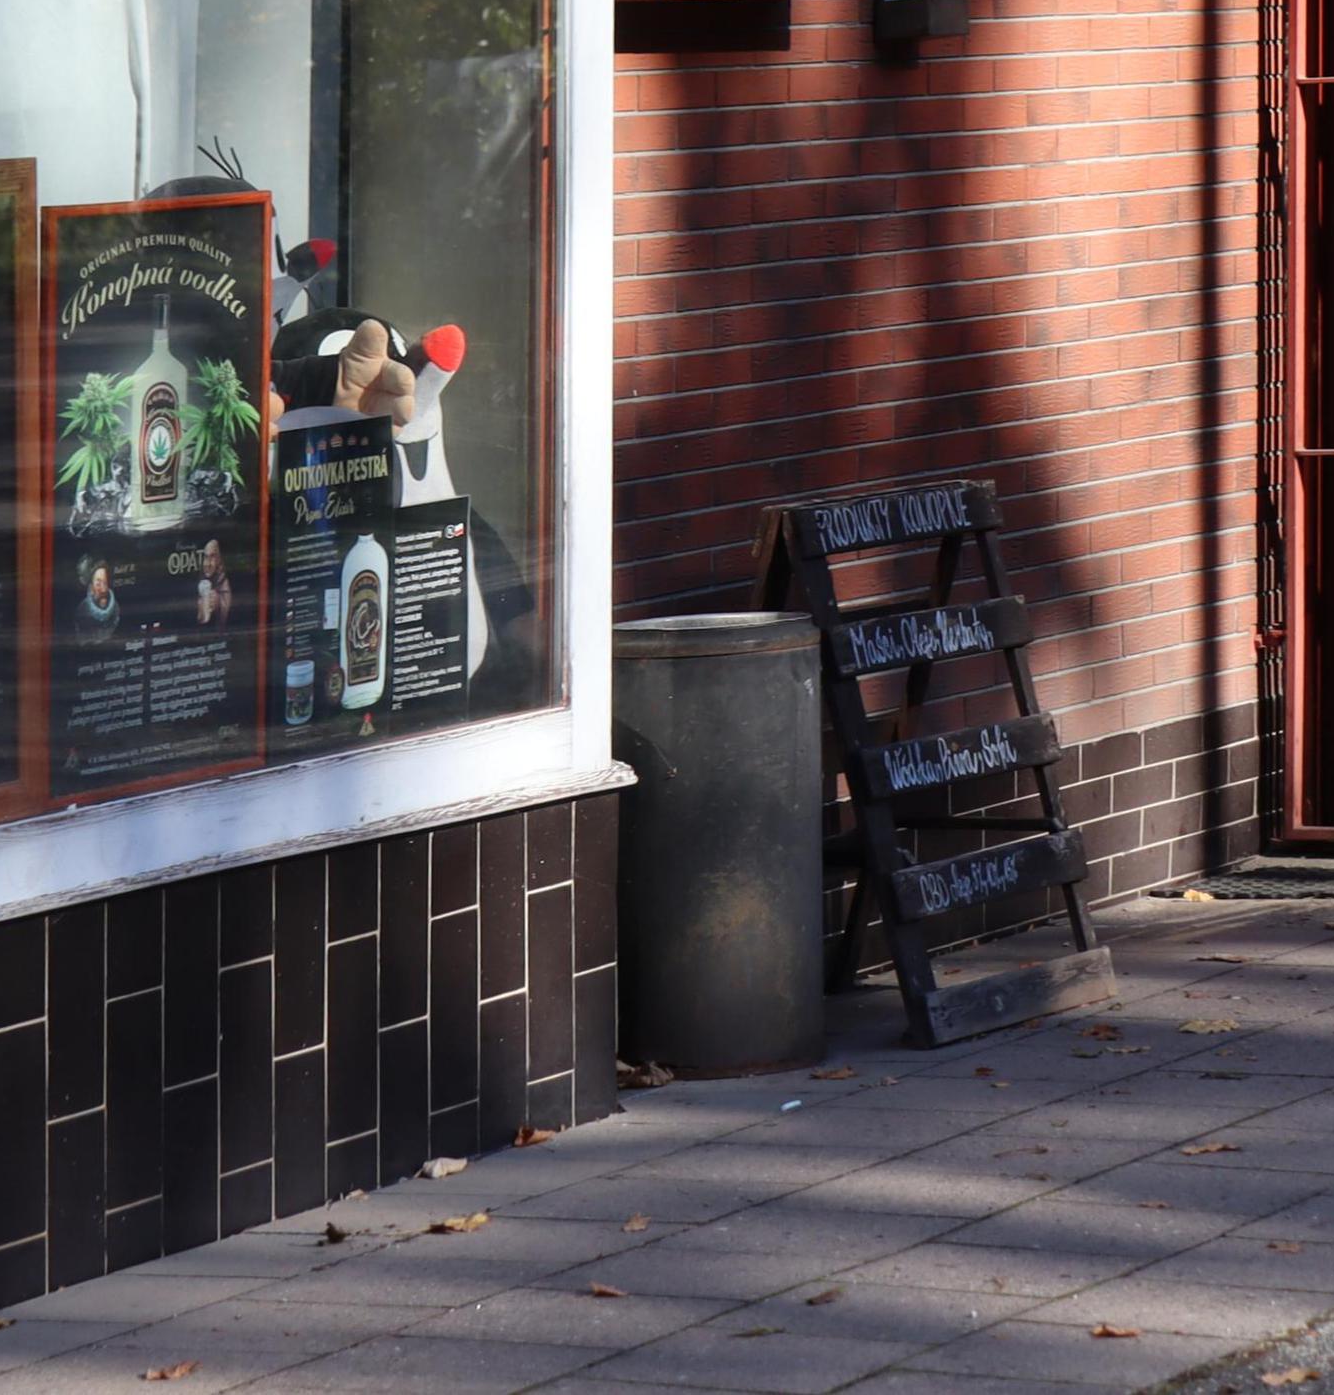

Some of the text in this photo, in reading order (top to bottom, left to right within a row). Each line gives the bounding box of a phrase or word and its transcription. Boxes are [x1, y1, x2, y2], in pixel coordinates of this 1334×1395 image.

[79, 233, 233, 279] ORIGINAL PREMIUM QUALITY
[62, 257, 248, 340] Konopná vodka
[284, 447, 389, 493] OUTKOVKA PESTRÁ
[814, 498, 893, 553] PRODUKTY
